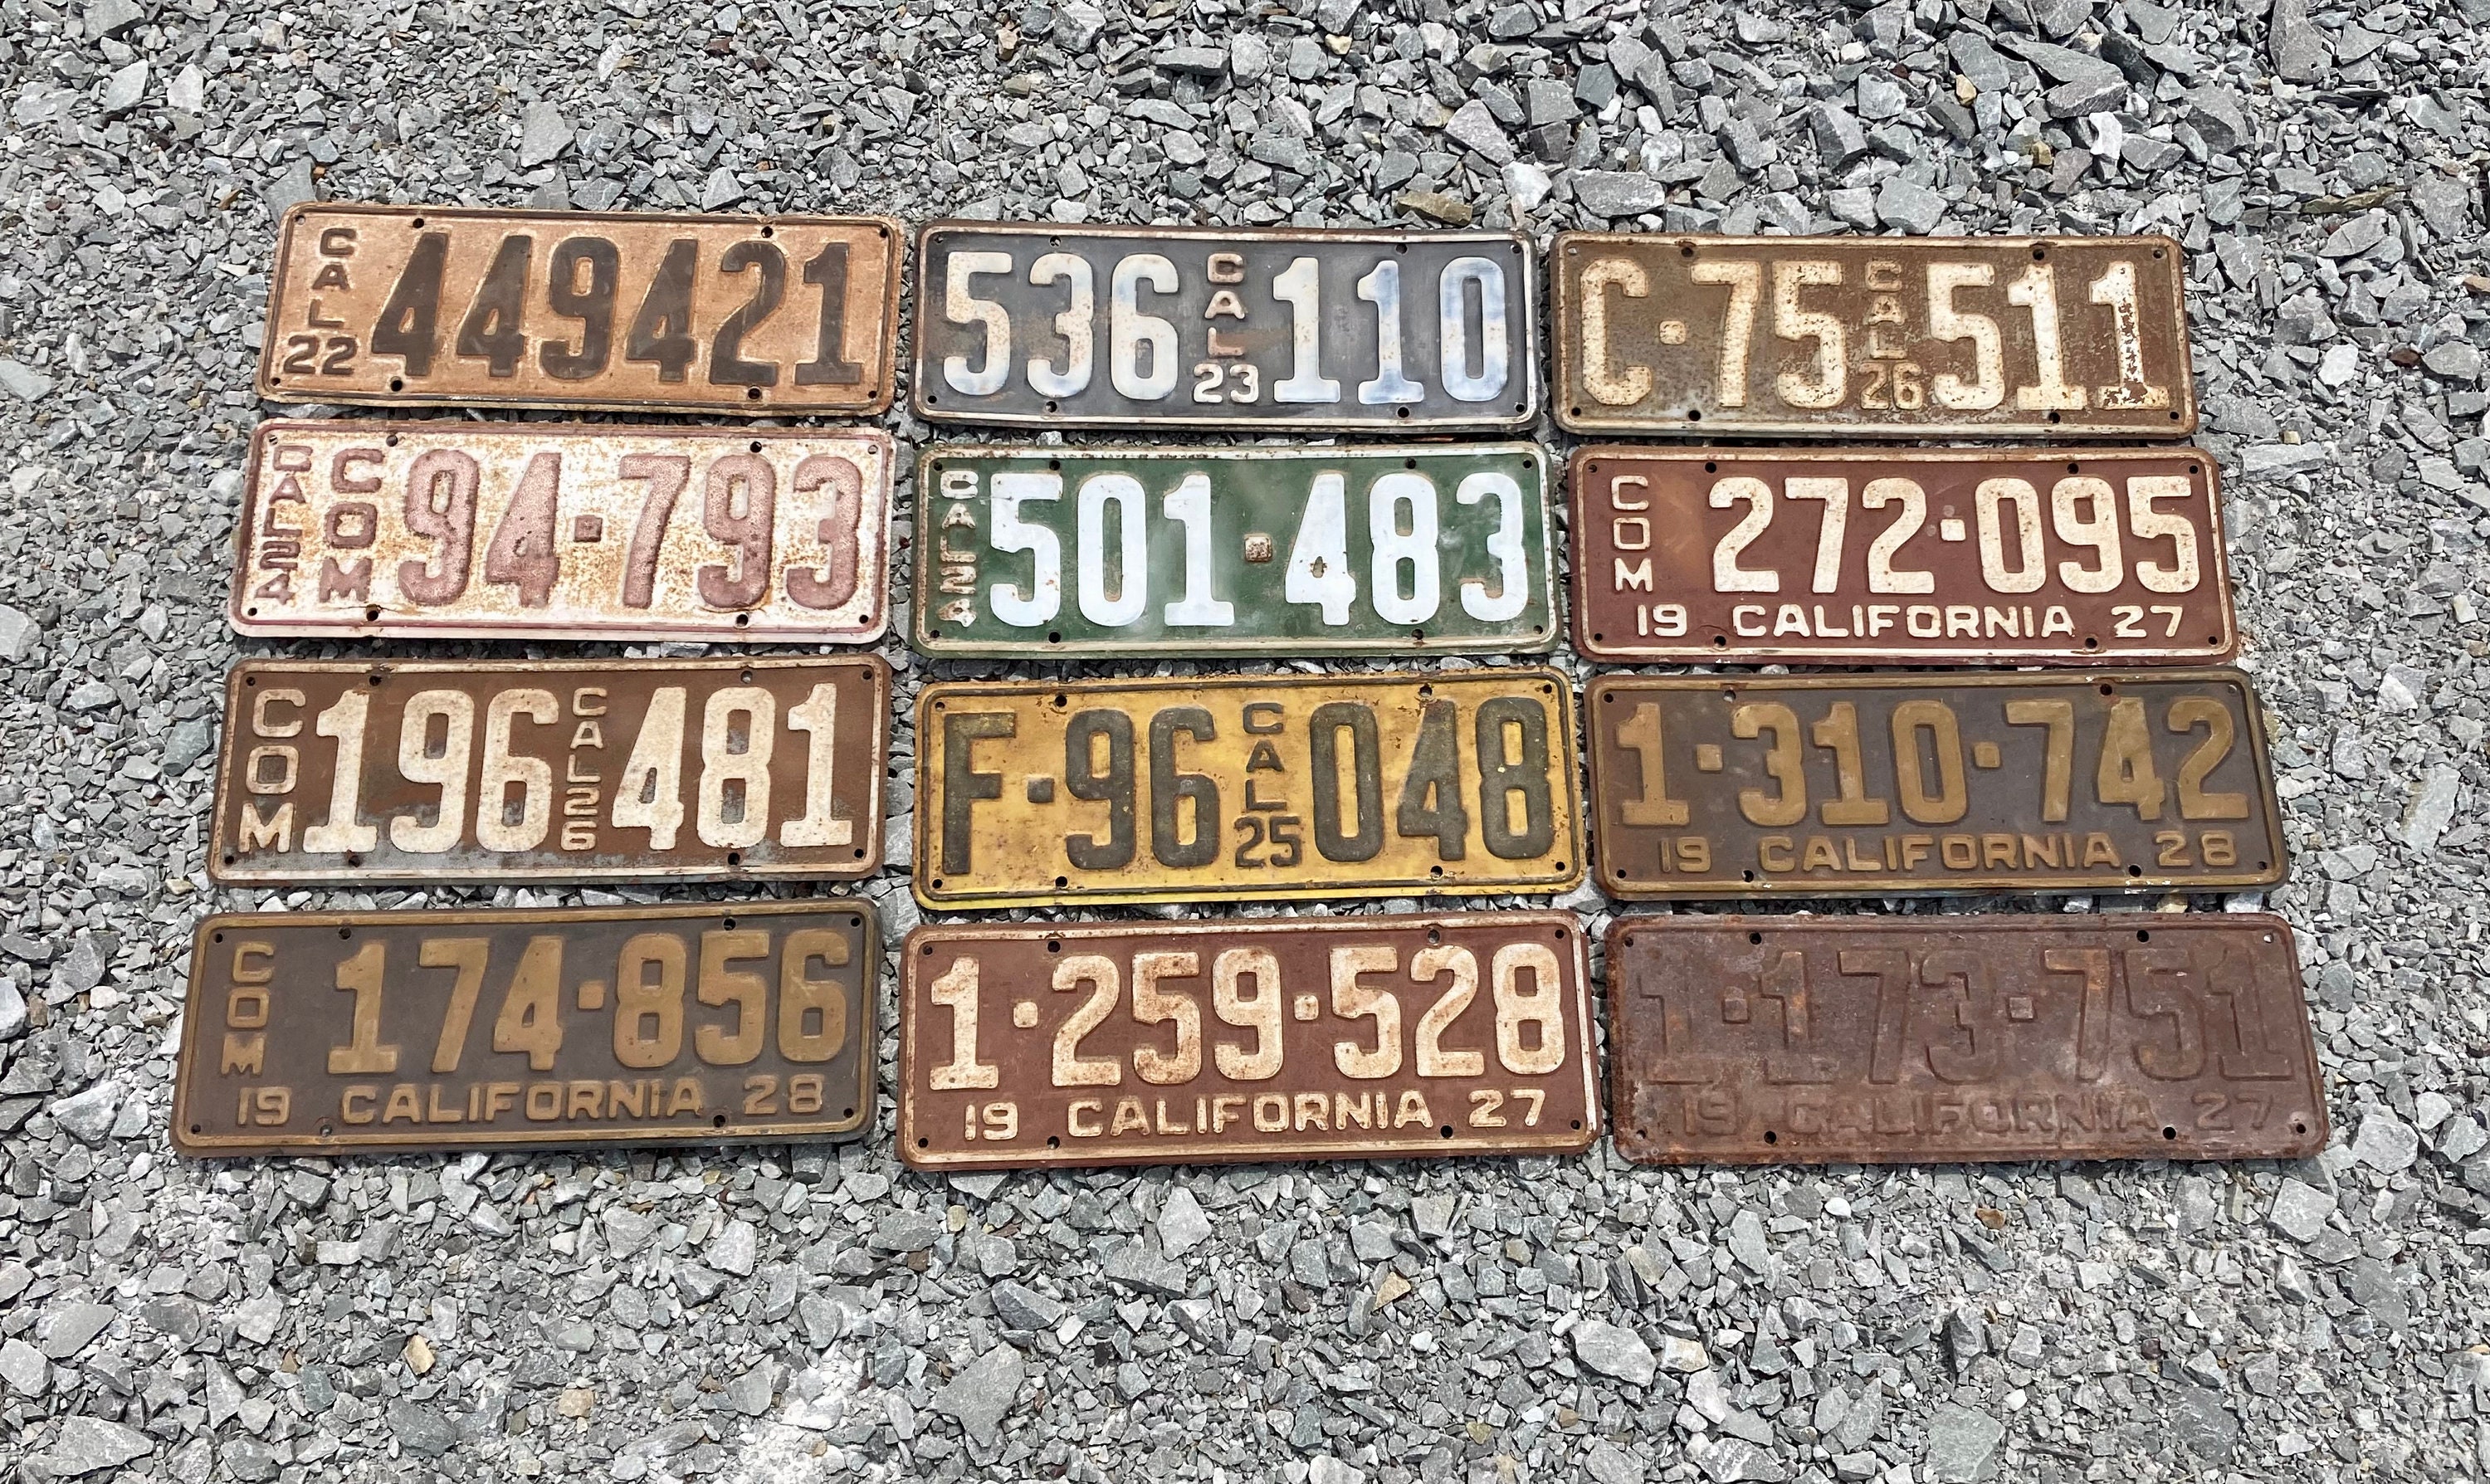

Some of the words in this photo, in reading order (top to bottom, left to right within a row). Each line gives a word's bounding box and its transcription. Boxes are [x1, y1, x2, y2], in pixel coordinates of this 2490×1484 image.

[312, 228, 355, 330] CAL
[370, 232, 862, 386] 449421
[943, 251, 1179, 400] 536
[1204, 253, 1245, 358] CAL
[1272, 256, 1506, 404] 110
[1864, 260, 1905, 360] CAL
[283, 334, 358, 376] 22
[1193, 364, 1259, 403] 23
[1859, 361, 1923, 411] 26
[1926, 261, 2170, 411] 511
[319, 448, 384, 603] COM
[1611, 475, 1653, 592] COM
[1638, 603, 1687, 637] 19
[1732, 603, 2075, 639] CALIFORNIA
[2111, 605, 2183, 639] 27
[237, 688, 305, 854] COM
[302, 688, 559, 854] 196
[611, 683, 852, 851] 481
[1243, 702, 1285, 813] CAL
[1311, 696, 1555, 862] 048
[1233, 816, 1304, 868] 25
[1660, 835, 1711, 873] 19
[1757, 834, 2124, 873] CALIFORNIA
[2156, 831, 2238, 868] 28
[221, 941, 275, 1076] COM
[237, 1086, 290, 1125] 19
[341, 1077, 706, 1125] CALIFORNIA
[743, 1074, 825, 1115] 28
[964, 1101, 1019, 1141] 19
[1067, 1090, 1435, 1137] CALIFORNIA
[1468, 1088, 1547, 1128] 27
[1680, 1095, 1744, 1137] 19
[1783, 1091, 2160, 1137] CALIFORNIA
[2190, 1092, 2275, 1130] 27
